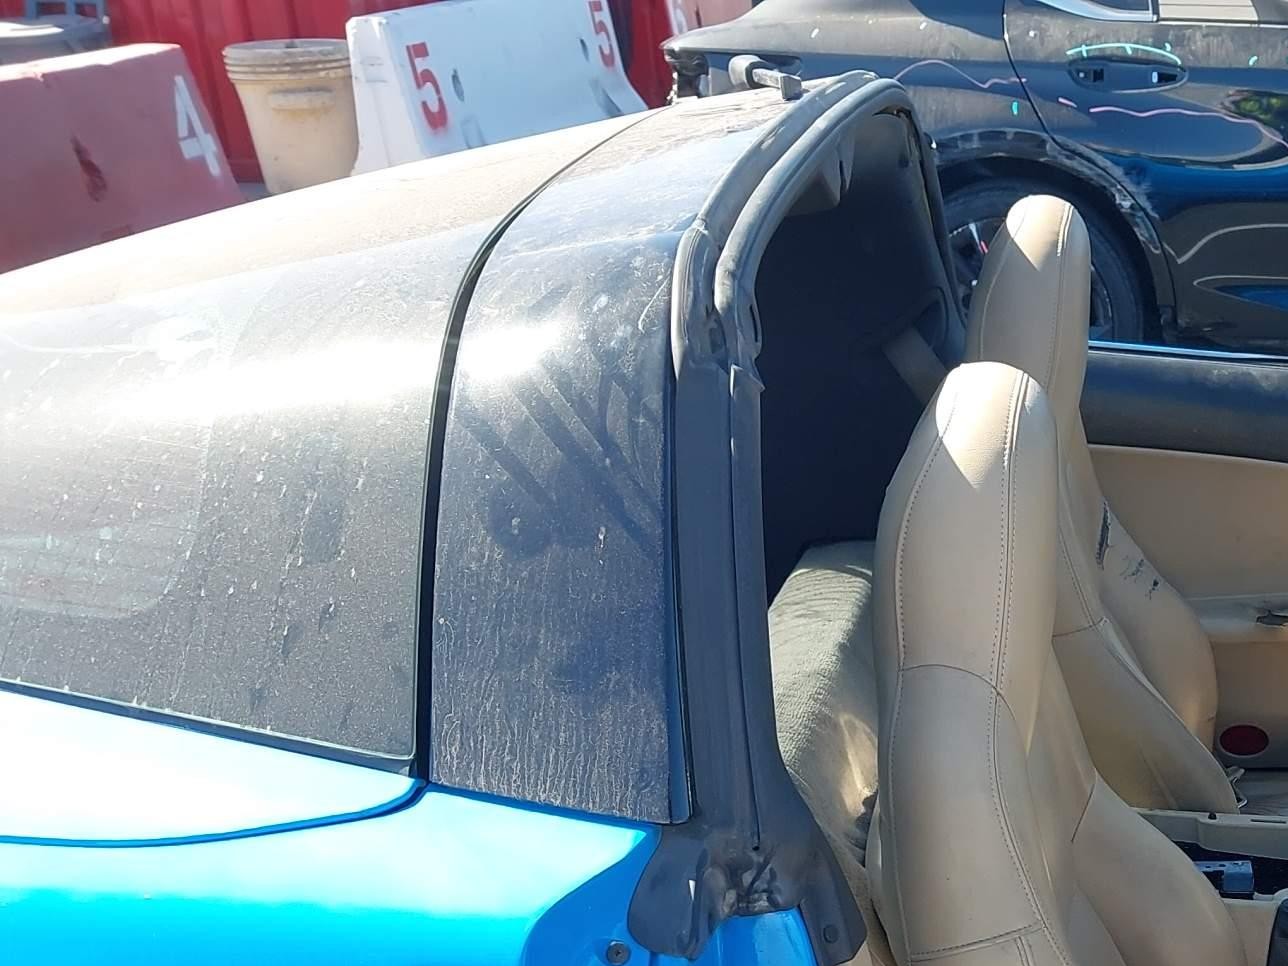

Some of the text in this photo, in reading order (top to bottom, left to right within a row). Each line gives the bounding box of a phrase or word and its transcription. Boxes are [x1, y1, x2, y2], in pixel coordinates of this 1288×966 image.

[588, 0, 615, 68] 5
[174, 75, 221, 177] 4
[406, 42, 448, 131] 5
